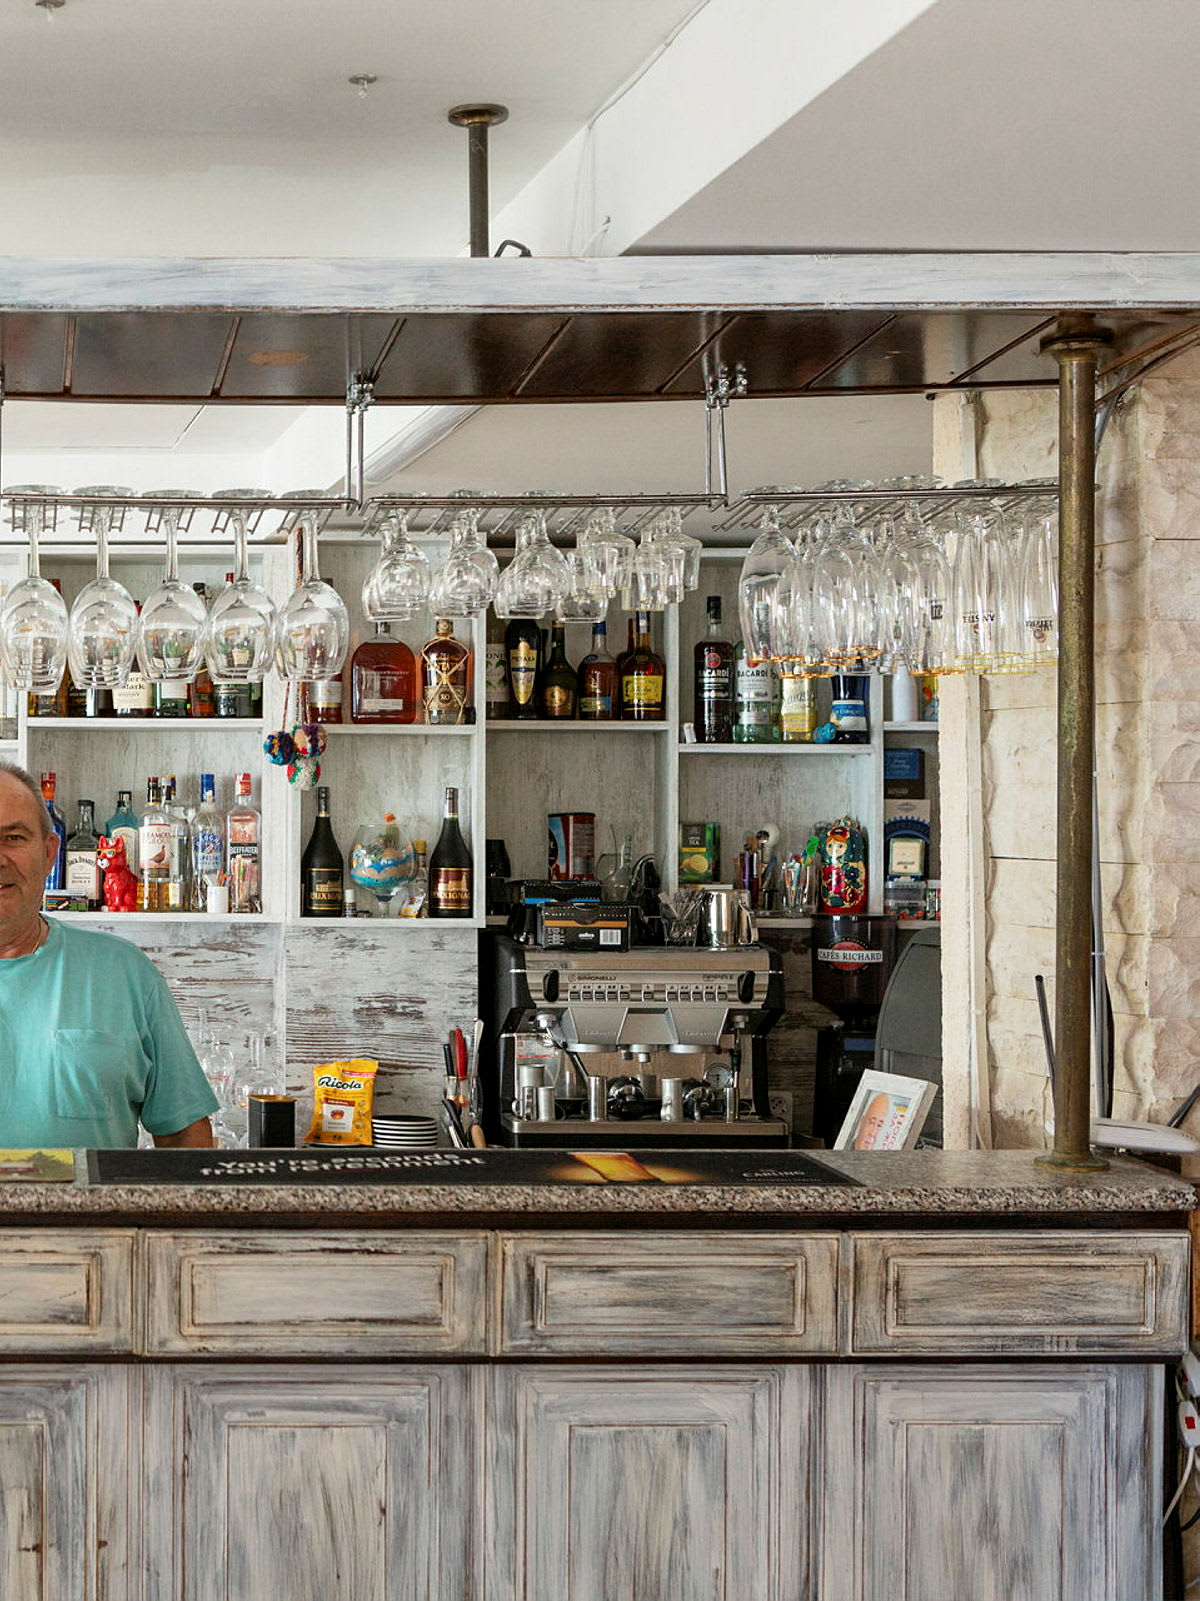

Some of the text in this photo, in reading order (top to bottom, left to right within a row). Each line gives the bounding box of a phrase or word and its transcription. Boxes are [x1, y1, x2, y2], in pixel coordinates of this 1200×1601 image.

[842, 952, 881, 961] RICHARD
[318, 1076, 363, 1090] Ricola
[199, 1157, 486, 1176] from refreshment
[217, 1153, 460, 1169] You're seconds
